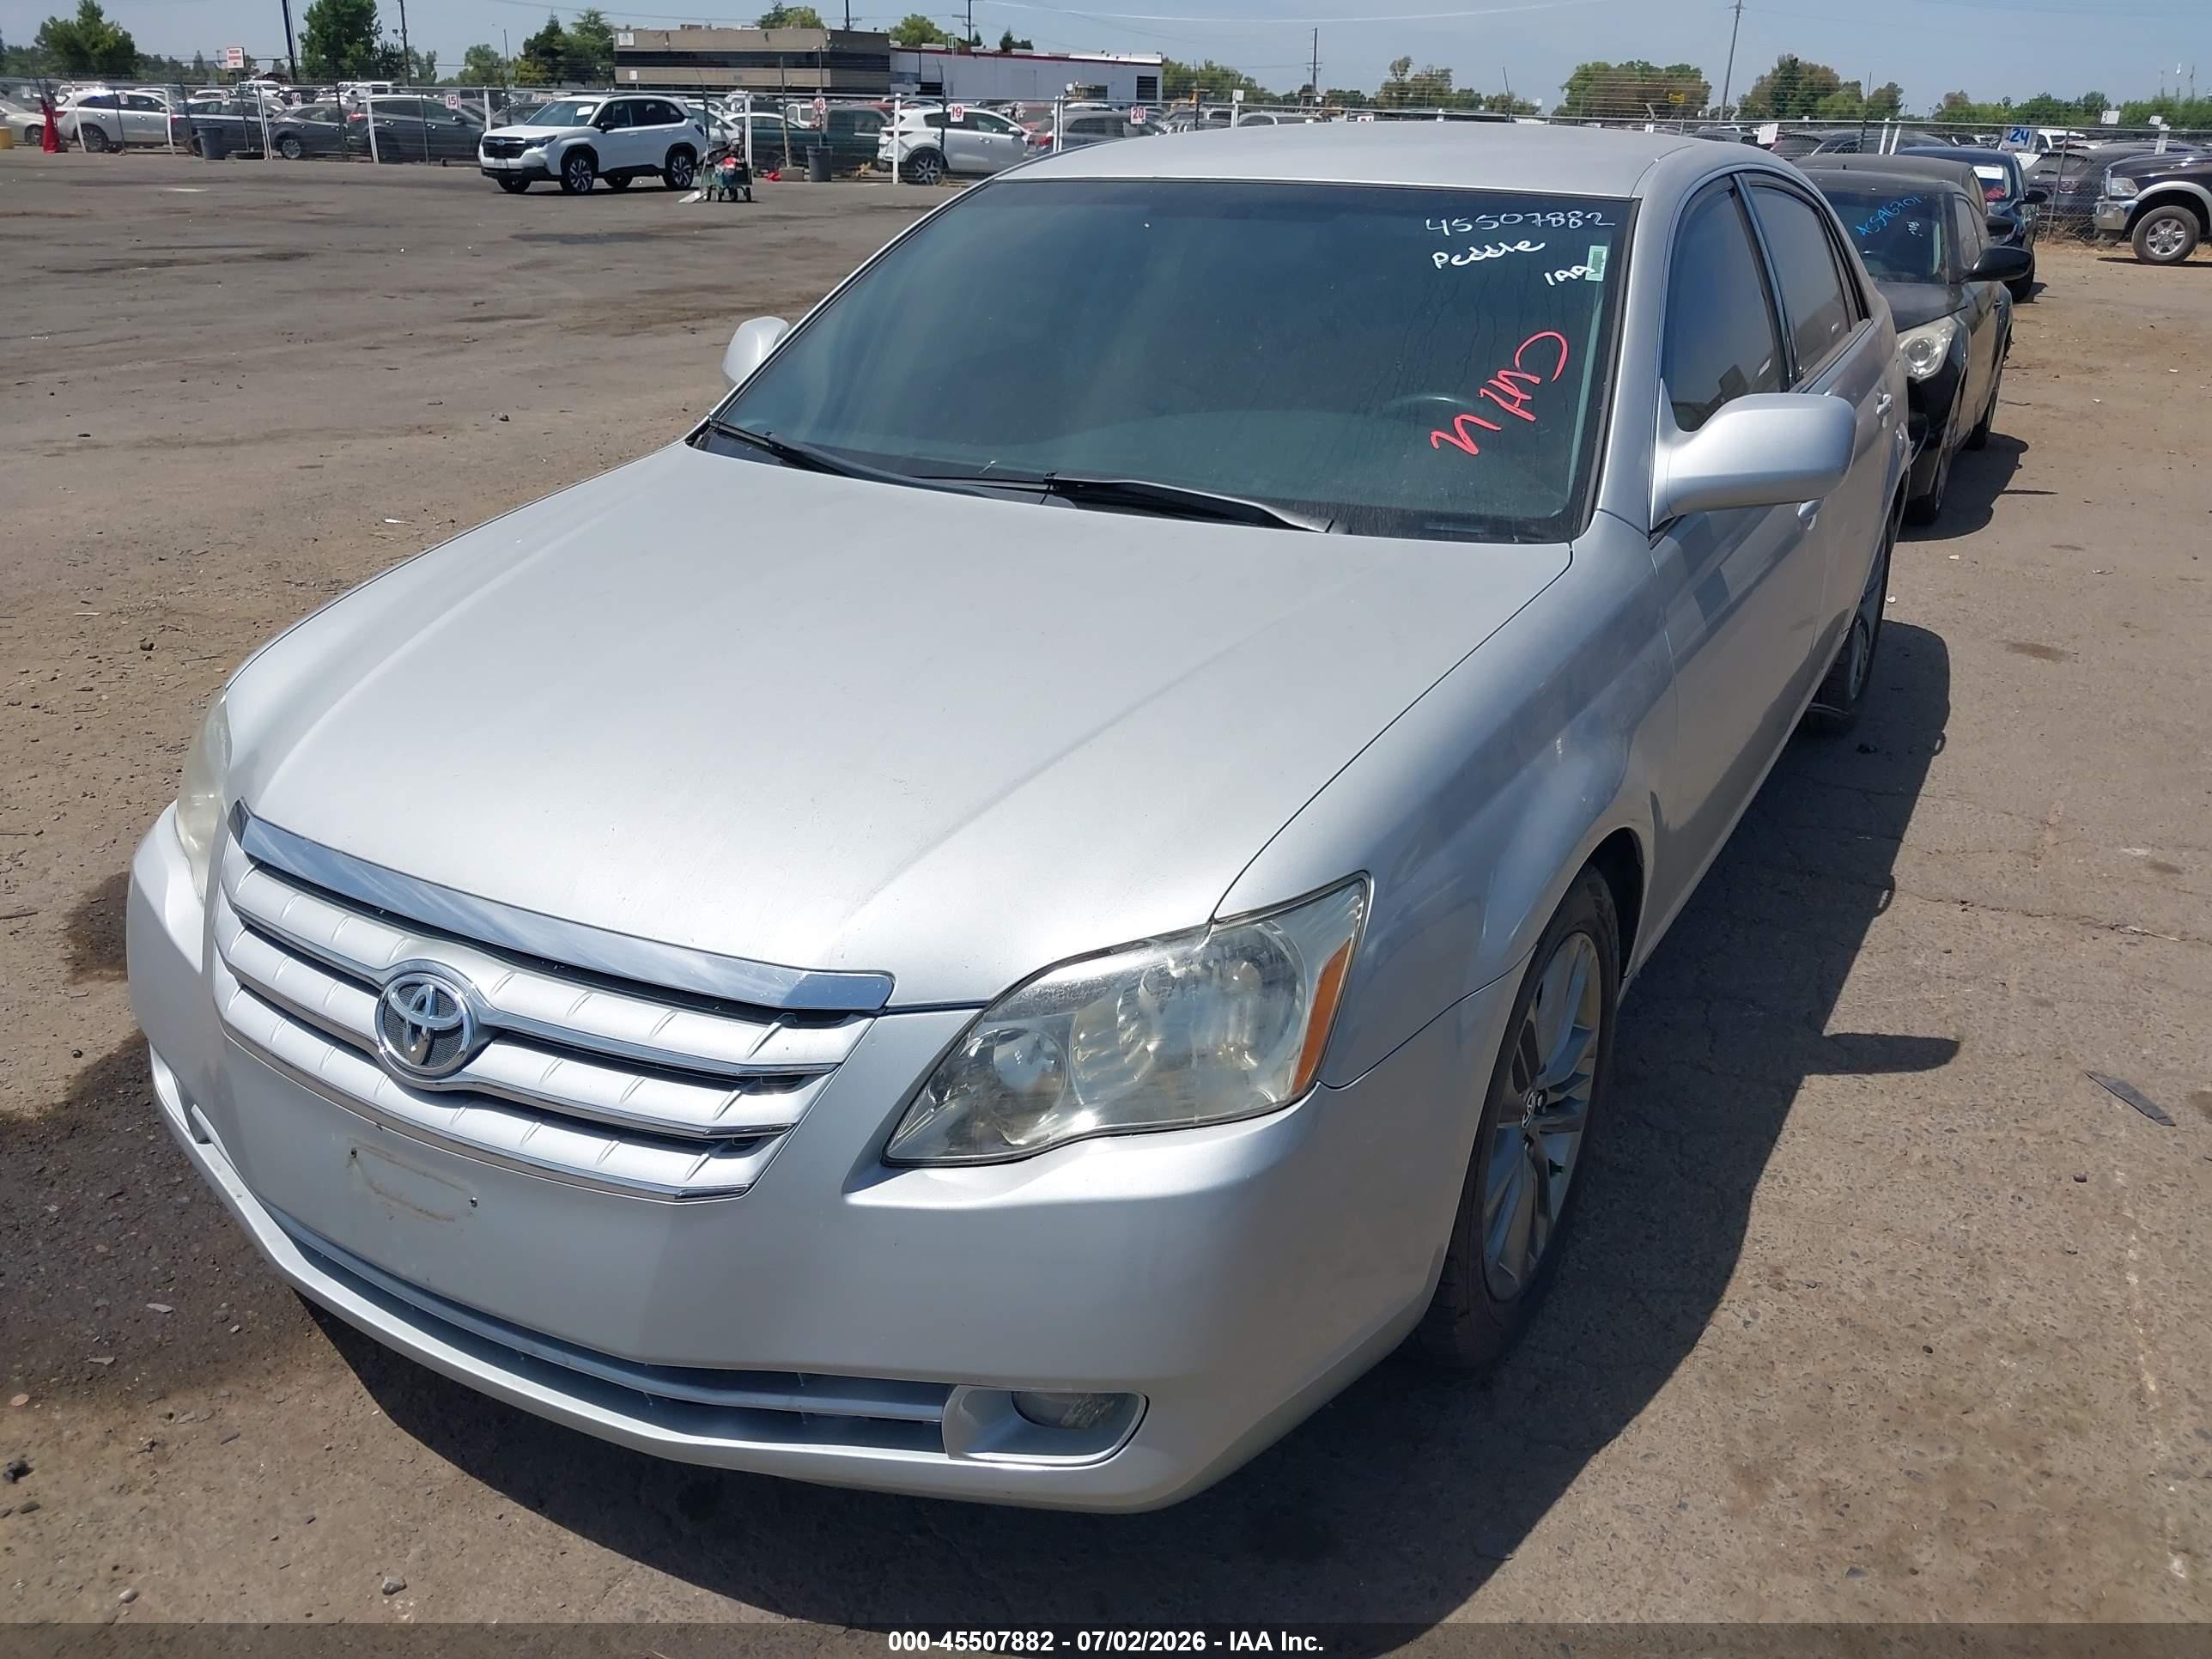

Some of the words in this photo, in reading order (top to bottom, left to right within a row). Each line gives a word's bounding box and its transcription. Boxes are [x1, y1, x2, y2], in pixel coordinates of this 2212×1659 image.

[447, 96, 457, 106] 15
[952, 106, 963, 118] 19
[1133, 108, 1144, 118] 20
[2009, 128, 2030, 146] 24
[1425, 210, 1615, 236] 45507882
[1544, 264, 1595, 286] IAA
